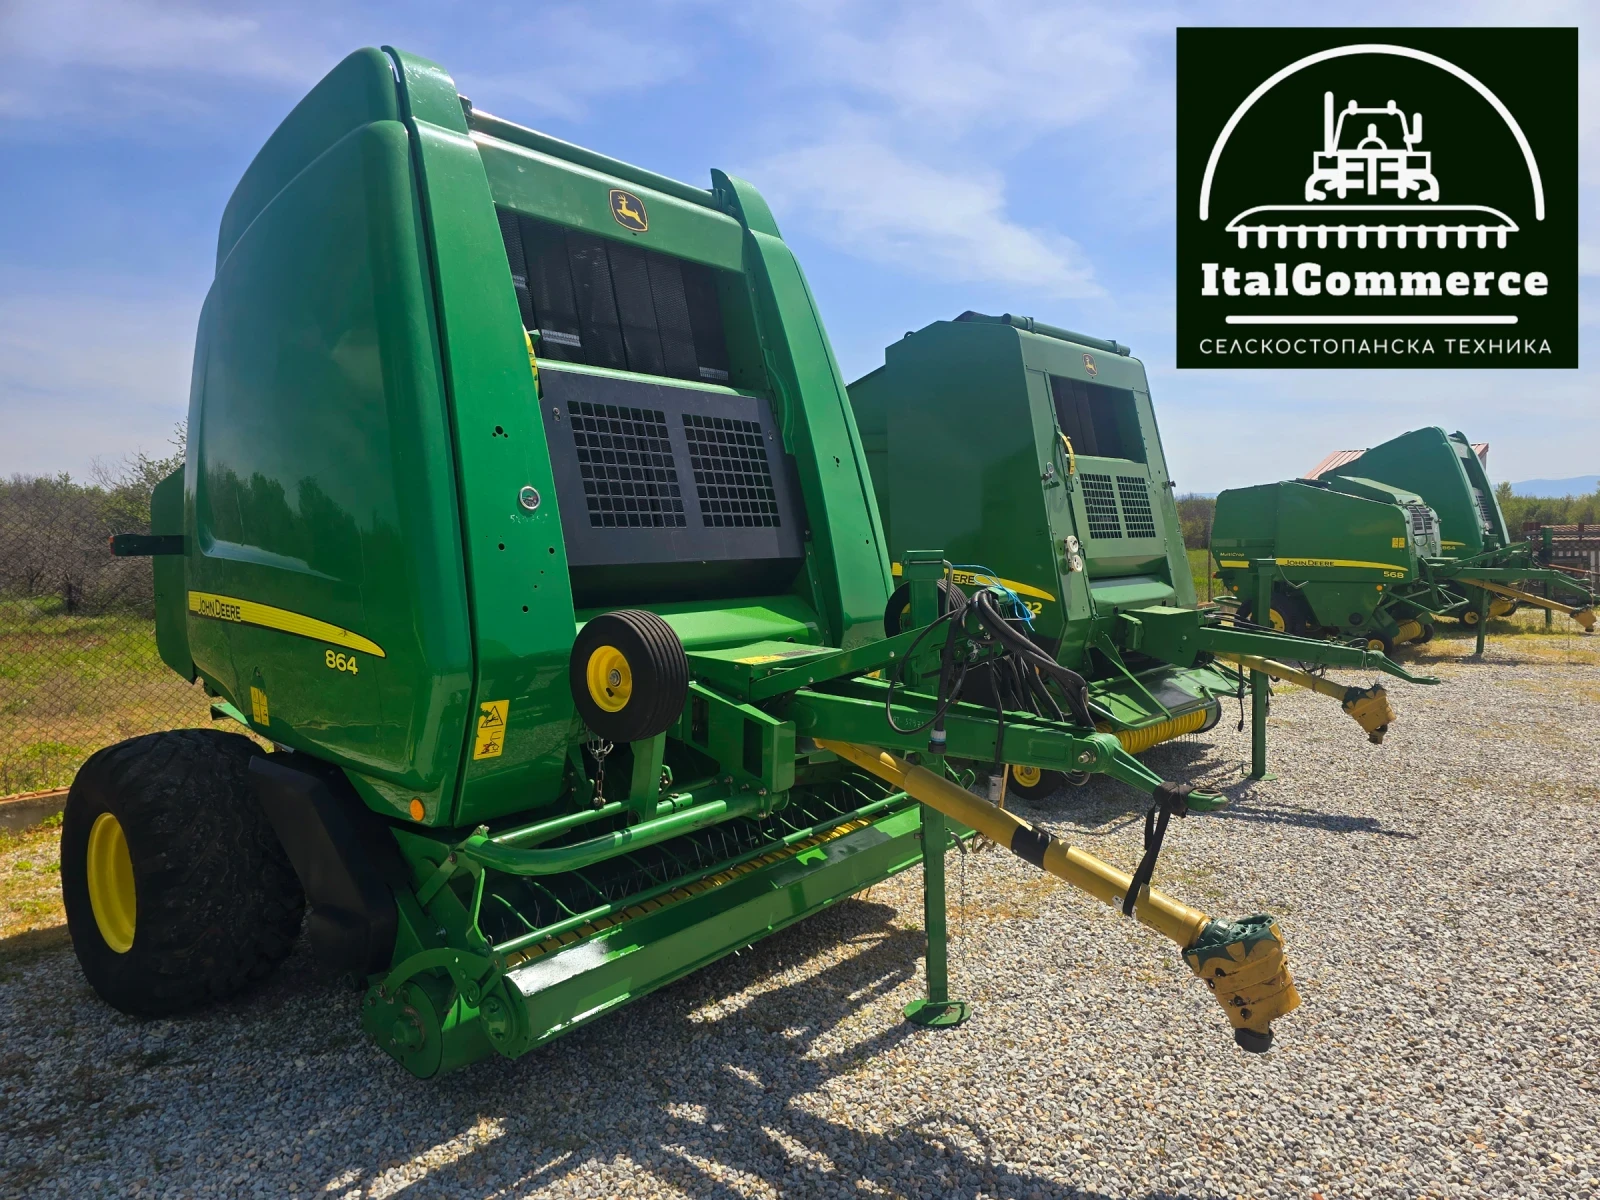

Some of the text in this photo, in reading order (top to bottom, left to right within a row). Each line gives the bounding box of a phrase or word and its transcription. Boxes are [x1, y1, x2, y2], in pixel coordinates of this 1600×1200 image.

[1286, 559, 1307, 567] JOHN
[1384, 571, 1404, 579] 568
[198, 596, 241, 620] JOHN DEERE
[325, 649, 358, 675] 864
